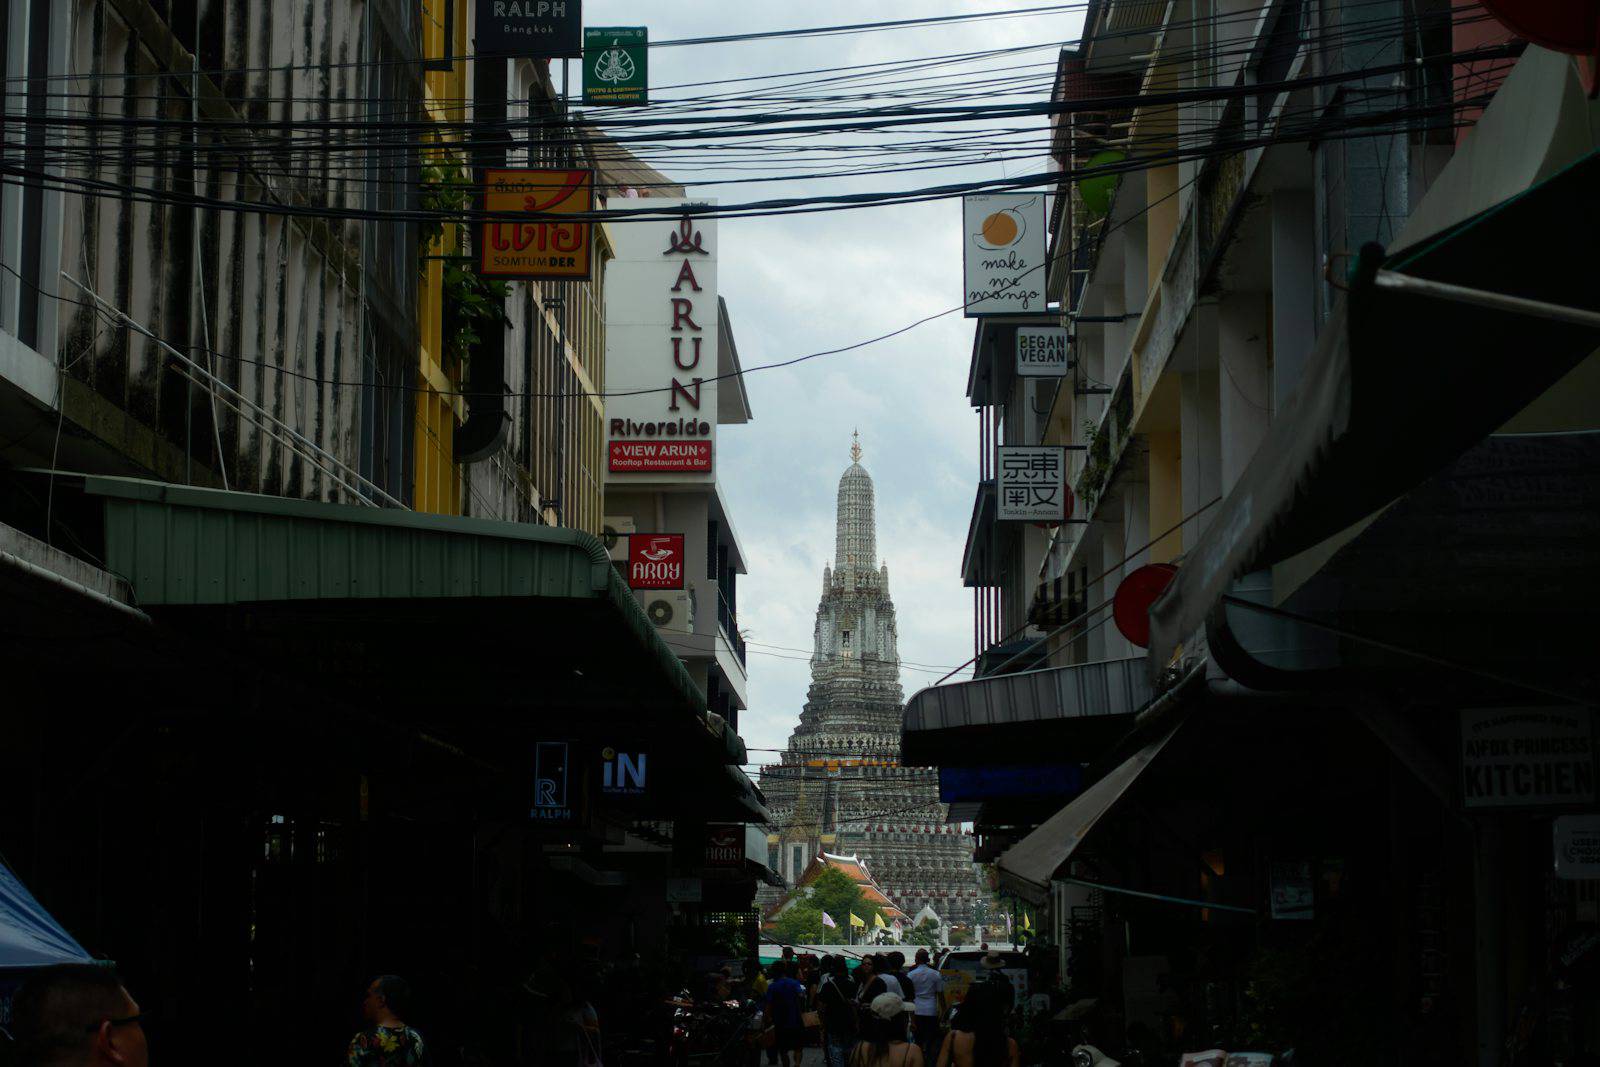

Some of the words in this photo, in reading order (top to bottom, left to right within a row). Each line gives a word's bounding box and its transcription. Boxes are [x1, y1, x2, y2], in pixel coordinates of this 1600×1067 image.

[493, 1, 566, 17] RALPH
[503, 24, 554, 35] Bangkok
[981, 250, 1028, 271] make
[989, 277, 1021, 288] me
[968, 290, 1040, 310] mango
[669, 258, 703, 411] ARUN
[1020, 335, 1065, 349] BEGAN
[1020, 349, 1065, 362] VEGAN
[610, 418, 710, 436] Riverside
[622, 445, 658, 456] VIEW
[660, 445, 698, 456] ARUN
[612, 458, 643, 467] Rooftop
[645, 458, 684, 466] Restaurant
[685, 458, 692, 466] &
[694, 458, 707, 466] Bar
[632, 562, 680, 580] AROY
[1464, 761, 1593, 797] KITCHEN
[530, 808, 571, 819] RALPH
